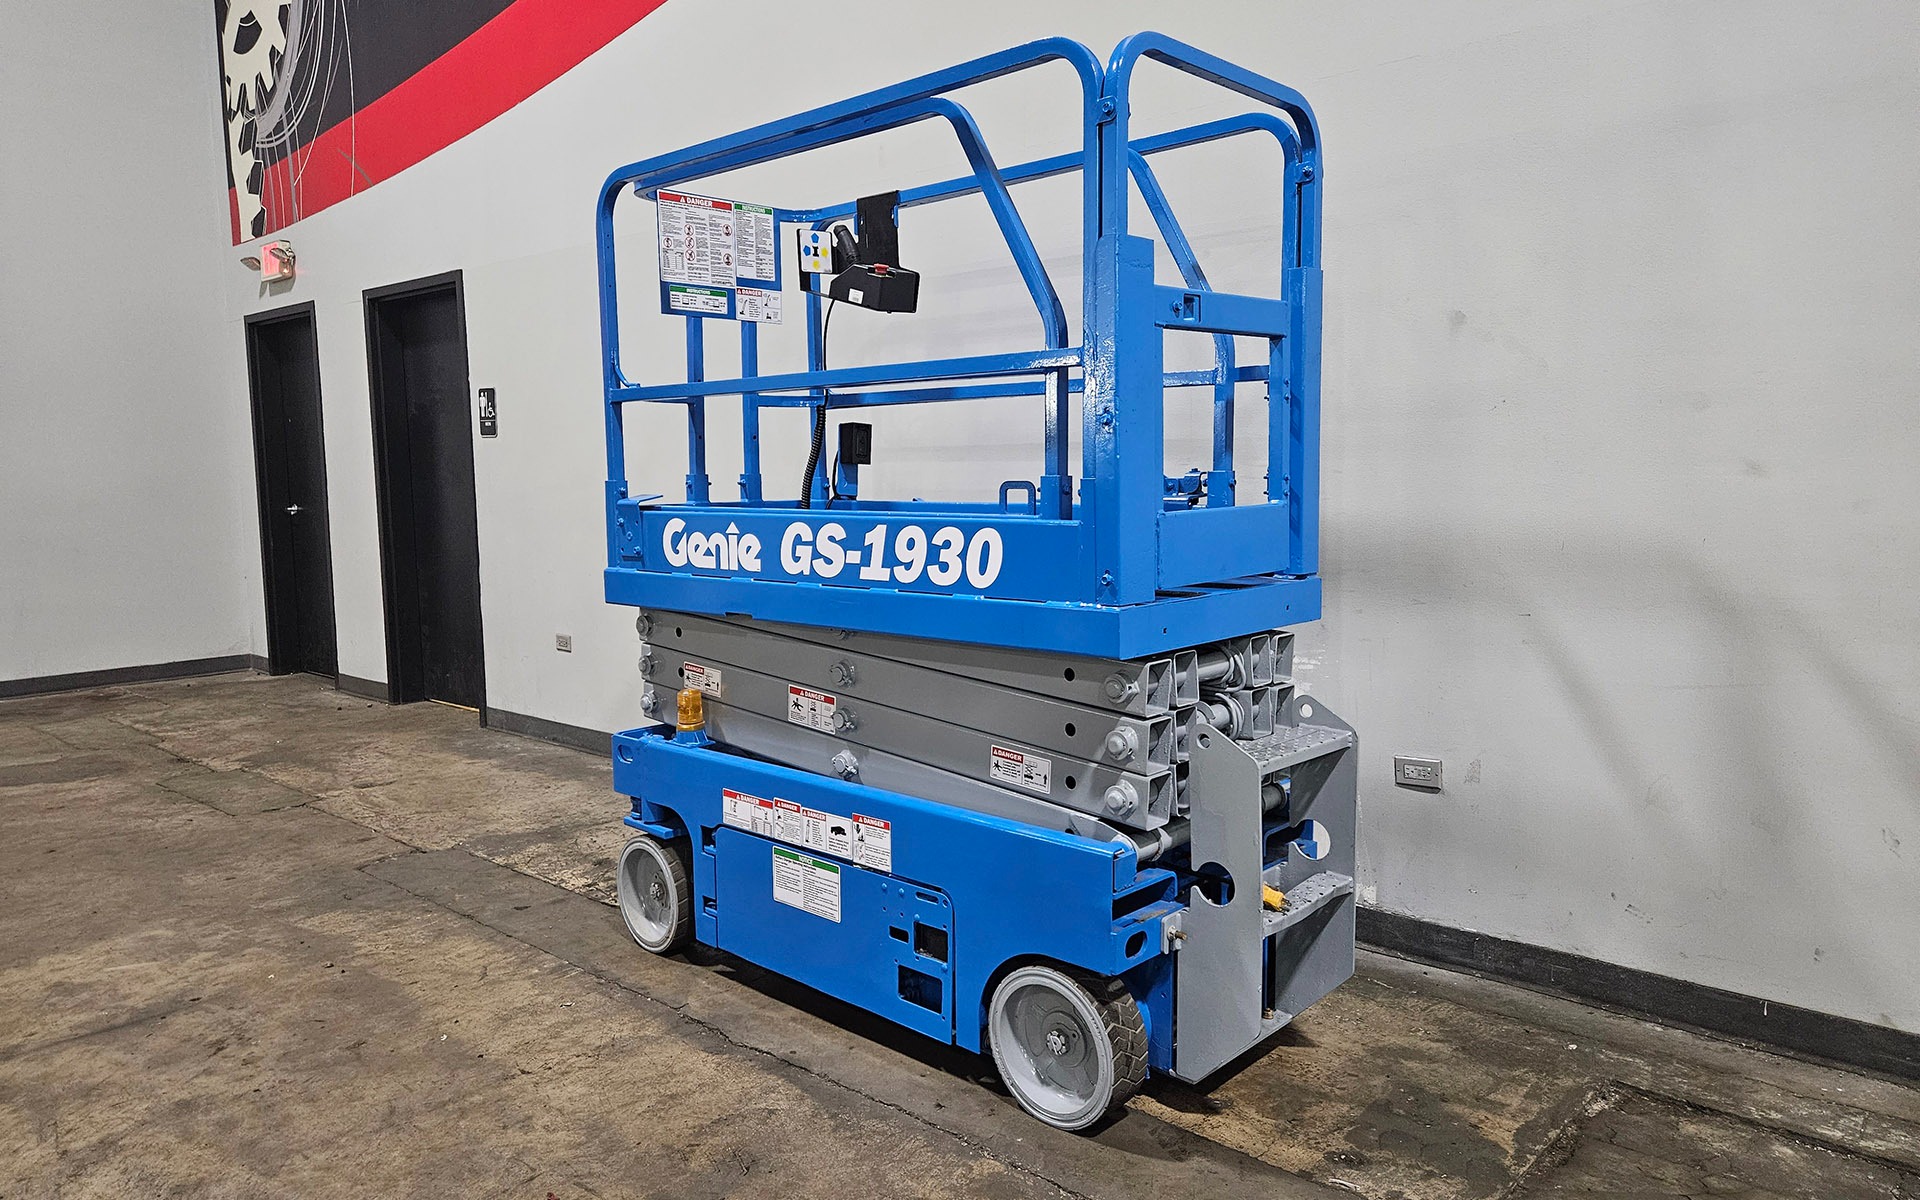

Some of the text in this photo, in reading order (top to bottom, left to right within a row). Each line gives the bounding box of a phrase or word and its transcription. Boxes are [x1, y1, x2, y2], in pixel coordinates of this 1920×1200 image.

[686, 197, 713, 207] DANGER
[741, 288, 762, 296] DANGER
[662, 517, 1003, 589] Genie GS-1930
[804, 690, 825, 701] DANGER
[997, 749, 1022, 762] DANGER
[741, 794, 760, 805] DANGER
[781, 802, 798, 811] DANGER
[807, 810, 826, 820] DANGER
[864, 817, 885, 828] DANGER
